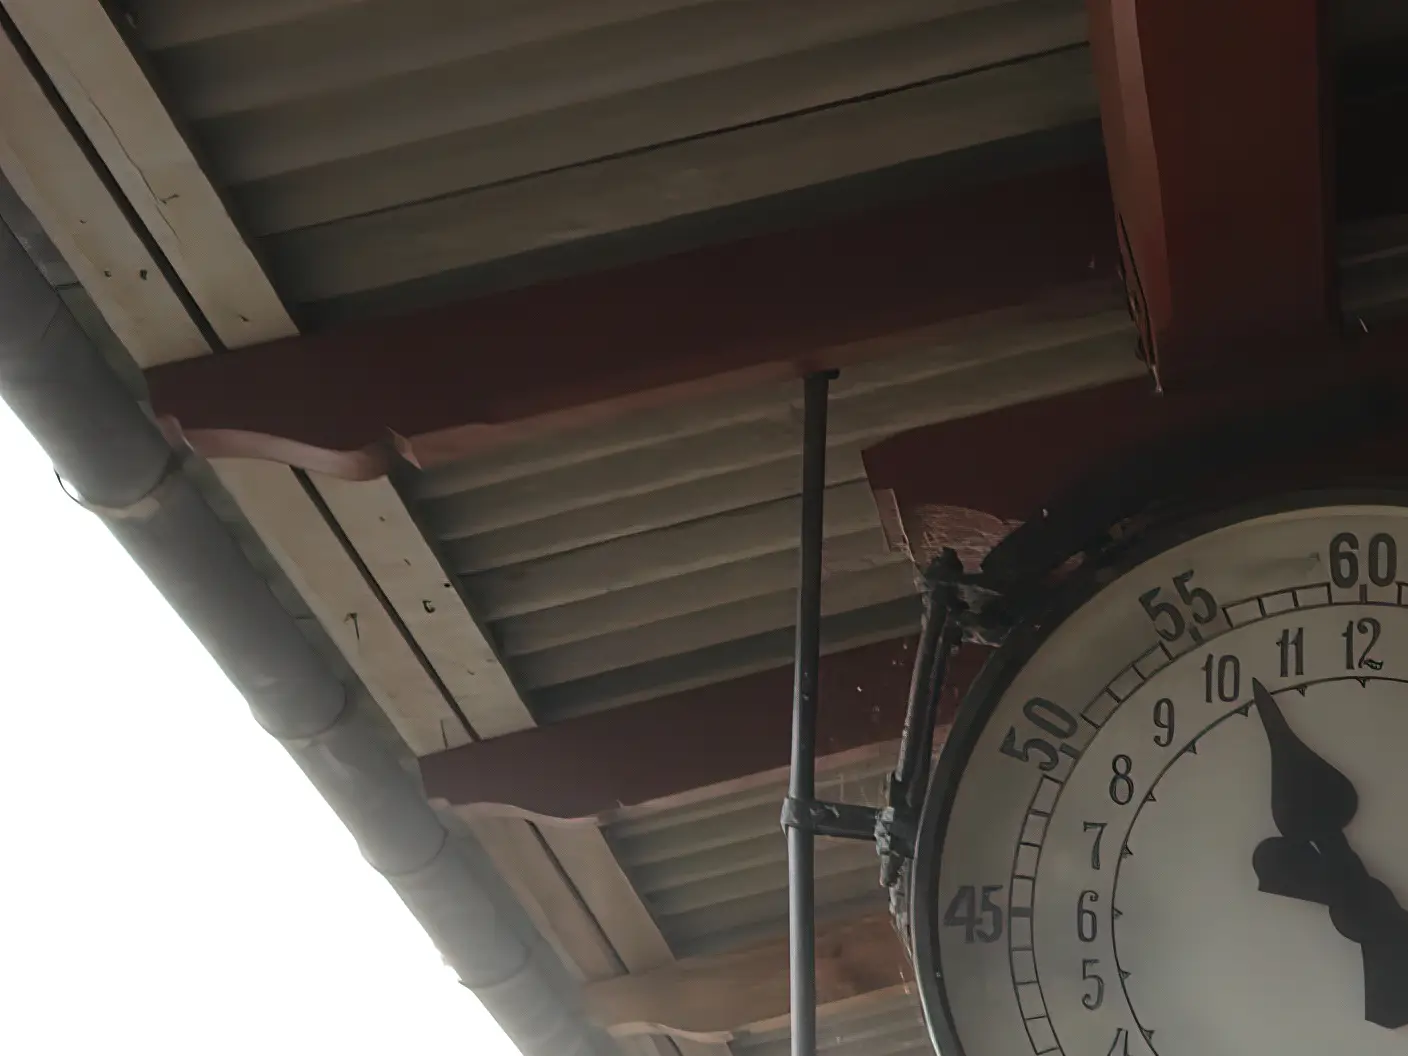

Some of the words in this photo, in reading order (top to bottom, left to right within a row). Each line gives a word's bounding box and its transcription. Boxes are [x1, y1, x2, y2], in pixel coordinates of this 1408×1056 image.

[1329, 532, 1398, 588] 60
[1138, 569, 1218, 642] 55
[1275, 626, 1305, 678] 11
[1341, 617, 1384, 671] 12
[1203, 654, 1241, 703] 10
[999, 696, 1079, 771] 50
[1153, 697, 1175, 747] 9
[1109, 754, 1134, 805] 8
[1082, 821, 1108, 870] 7
[943, 884, 1003, 944] 45
[1077, 889, 1099, 943] 6
[1081, 958, 1104, 1011] 5
